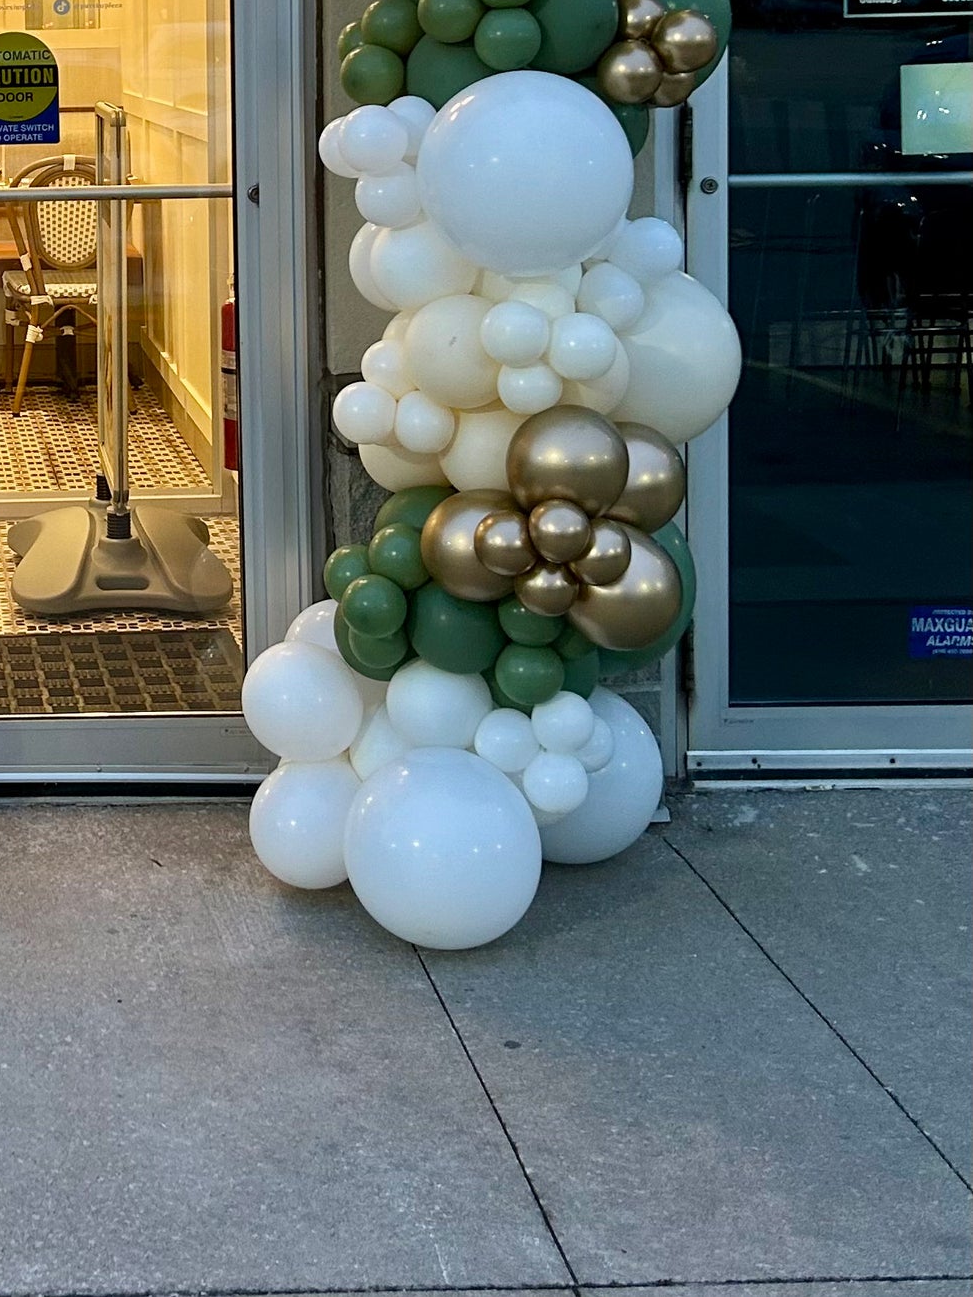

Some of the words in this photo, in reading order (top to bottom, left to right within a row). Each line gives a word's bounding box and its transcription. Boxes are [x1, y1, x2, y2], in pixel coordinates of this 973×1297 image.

[20, 124, 55, 132] SWITCH
[3, 133, 43, 141] OPERATE
[911, 617, 973, 633] MAXGUA
